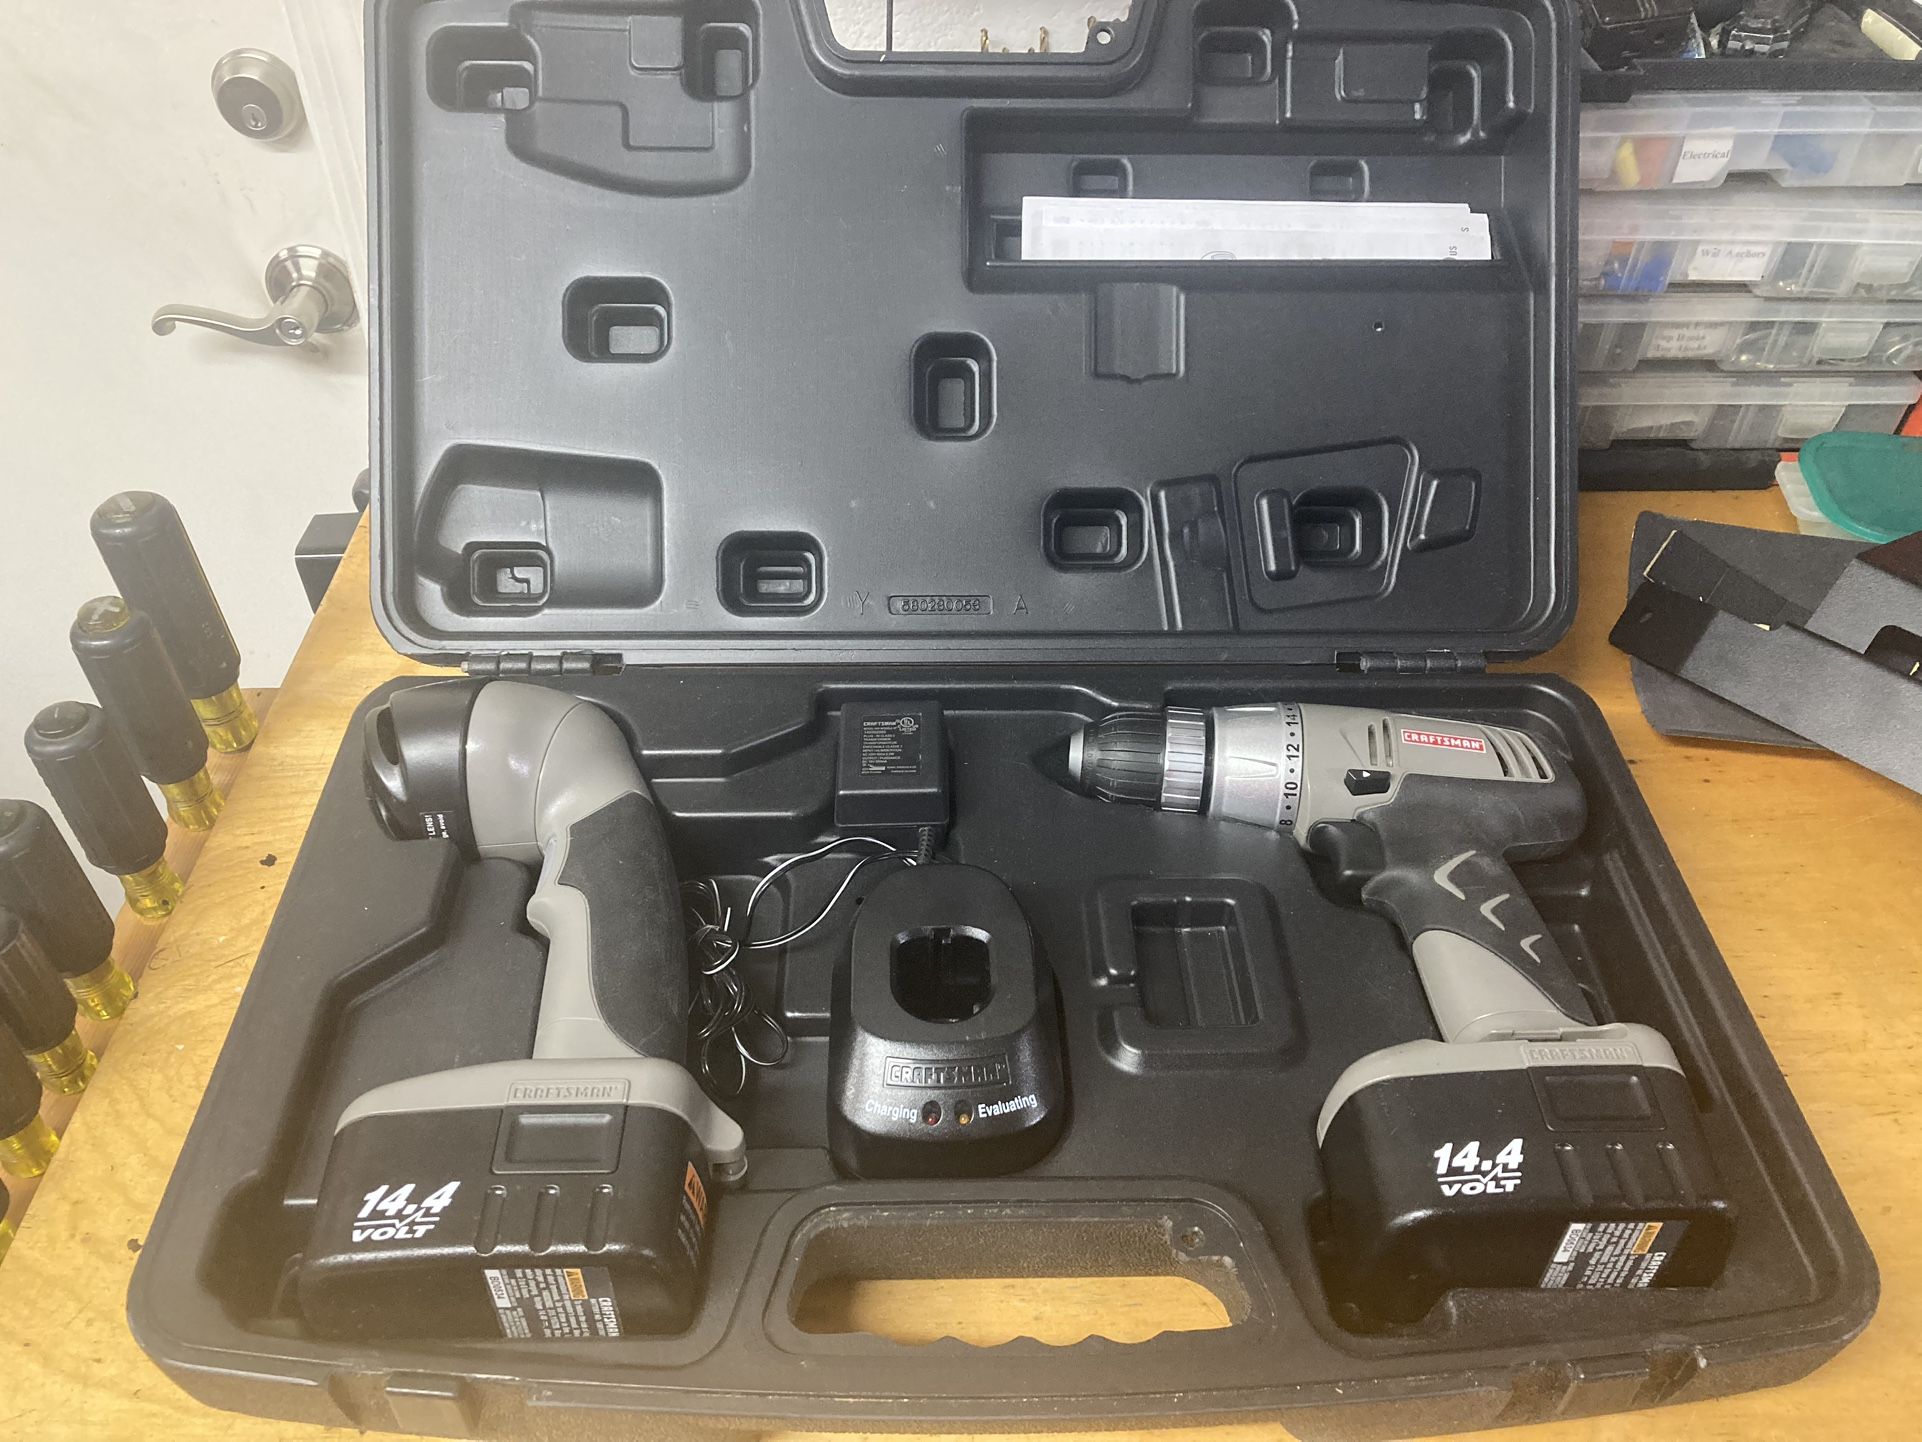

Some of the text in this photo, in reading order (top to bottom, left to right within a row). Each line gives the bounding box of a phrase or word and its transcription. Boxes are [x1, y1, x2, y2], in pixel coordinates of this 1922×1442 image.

[1682, 149, 1731, 161] Electrical
[855, 590, 871, 615] Y
[1012, 594, 1030, 615] A
[1404, 732, 1481, 749] CRAFTSMAN
[1280, 712, 1300, 827] 8 10 12 14
[1529, 1047, 1629, 1060] CRAFTSMAN
[890, 1063, 1001, 1085] CRAFTSMAN
[513, 1085, 614, 1099] CRAFTSMAN
[864, 1093, 1038, 1123] Charging Evaluating
[1433, 1138, 1525, 1175] 14.4
[1439, 1179, 1522, 1197] VOLT
[357, 1181, 461, 1219] 14.4
[352, 1223, 436, 1243] VOLT
[598, 1297, 620, 1336] CRAFTSMAN
